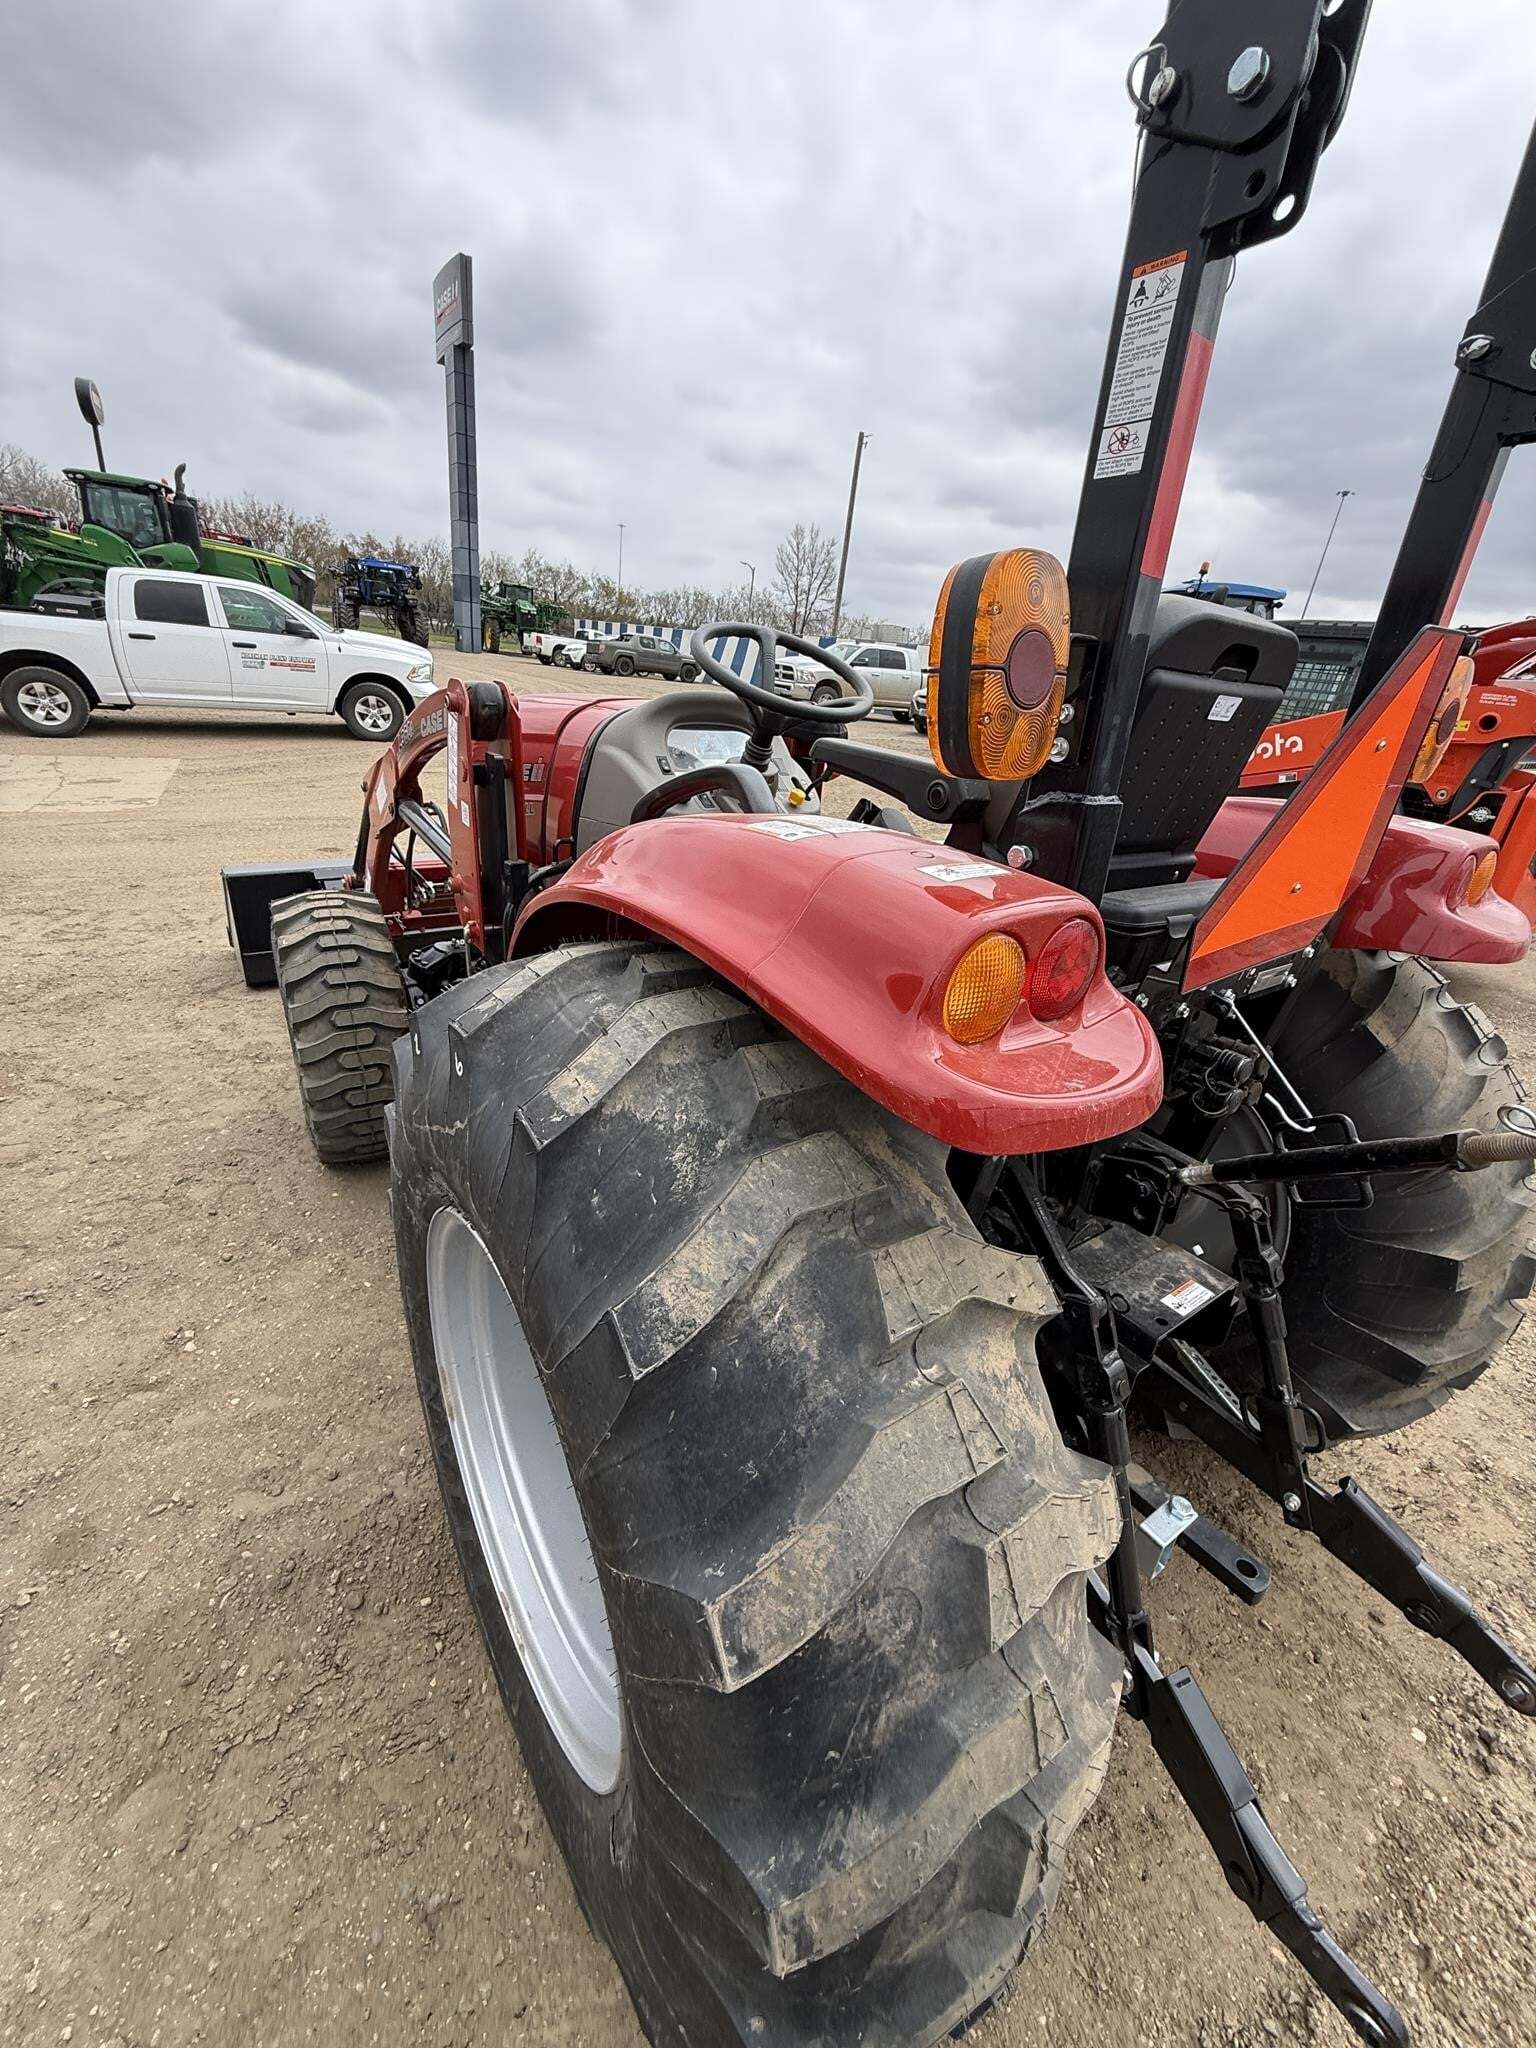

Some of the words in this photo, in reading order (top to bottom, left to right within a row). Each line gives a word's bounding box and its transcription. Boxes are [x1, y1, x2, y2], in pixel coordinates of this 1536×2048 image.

[1150, 254, 1180, 268] WARNING
[1134, 310, 1153, 322] prevent
[420, 710, 443, 738] CASE
[454, 1051, 464, 1077] 6
